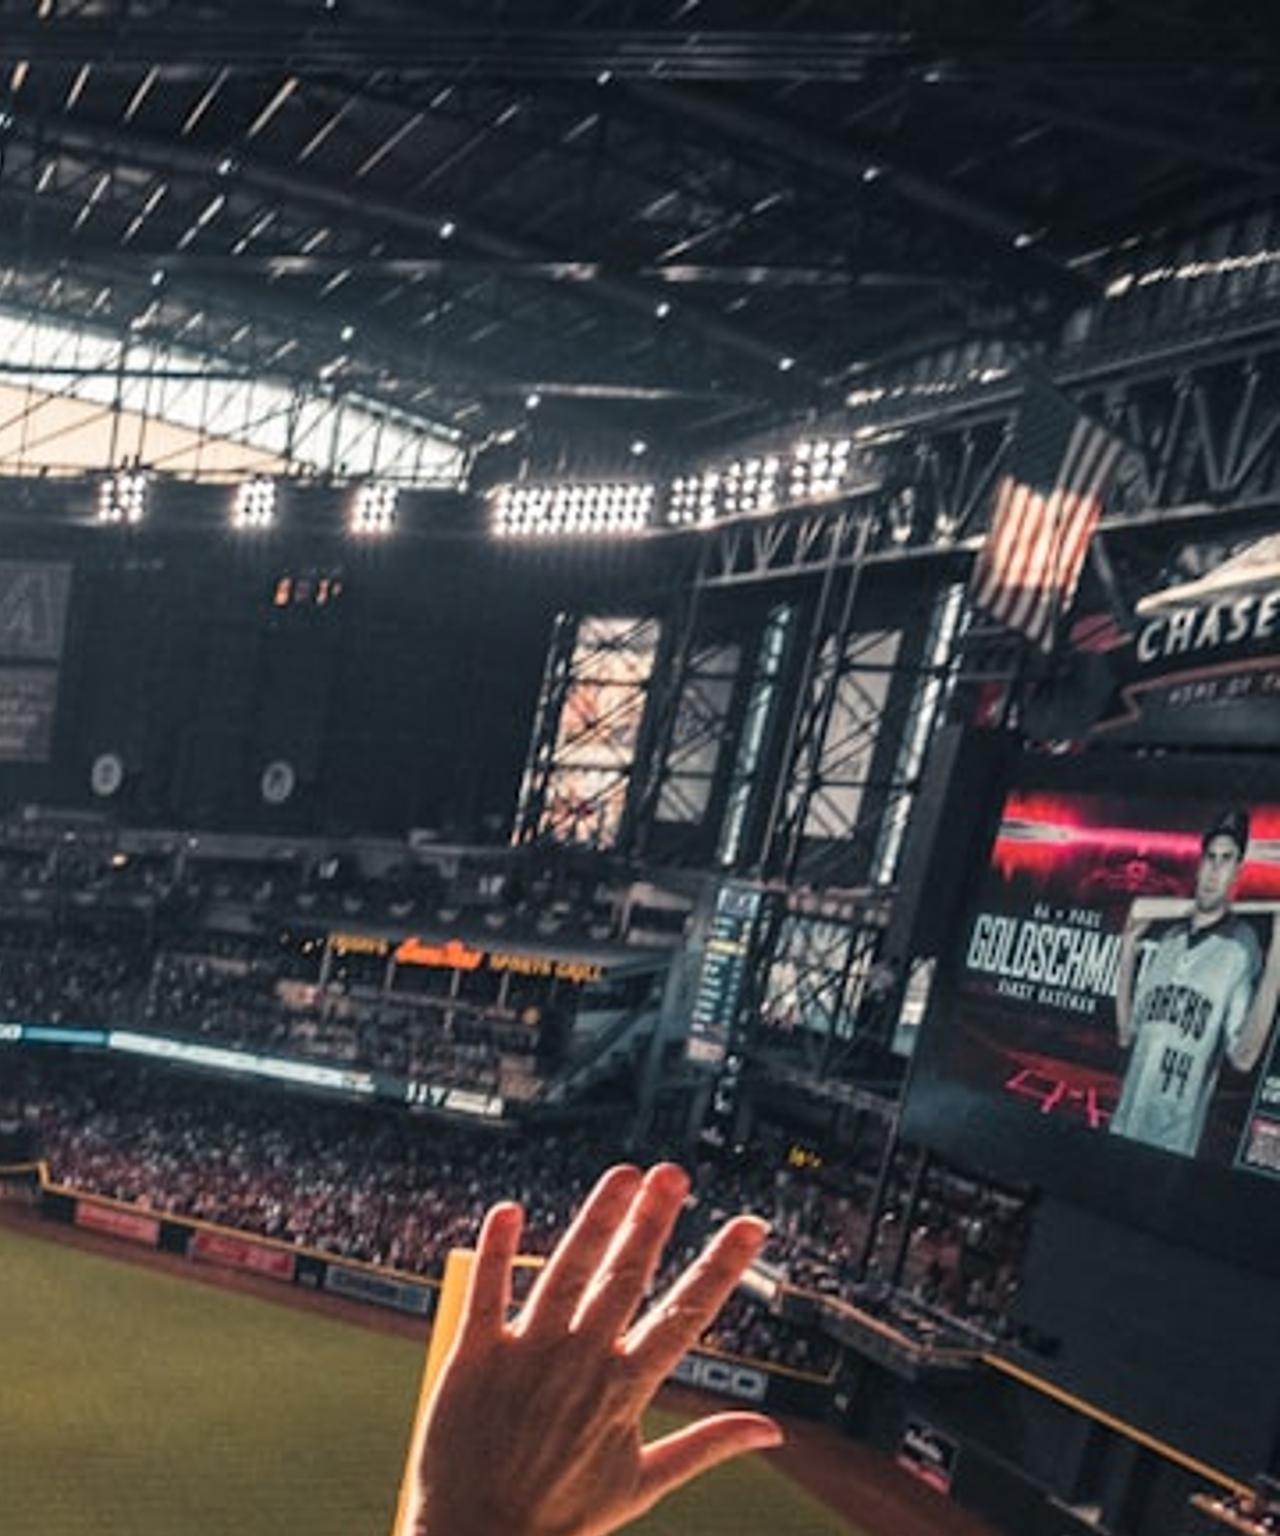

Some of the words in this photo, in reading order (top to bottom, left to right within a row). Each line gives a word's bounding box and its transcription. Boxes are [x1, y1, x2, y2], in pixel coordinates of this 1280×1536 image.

[1137, 589, 1280, 662] CHASE
[966, 913, 1159, 998] GOLDSCHMIT
[674, 1354, 769, 1402] EICO
